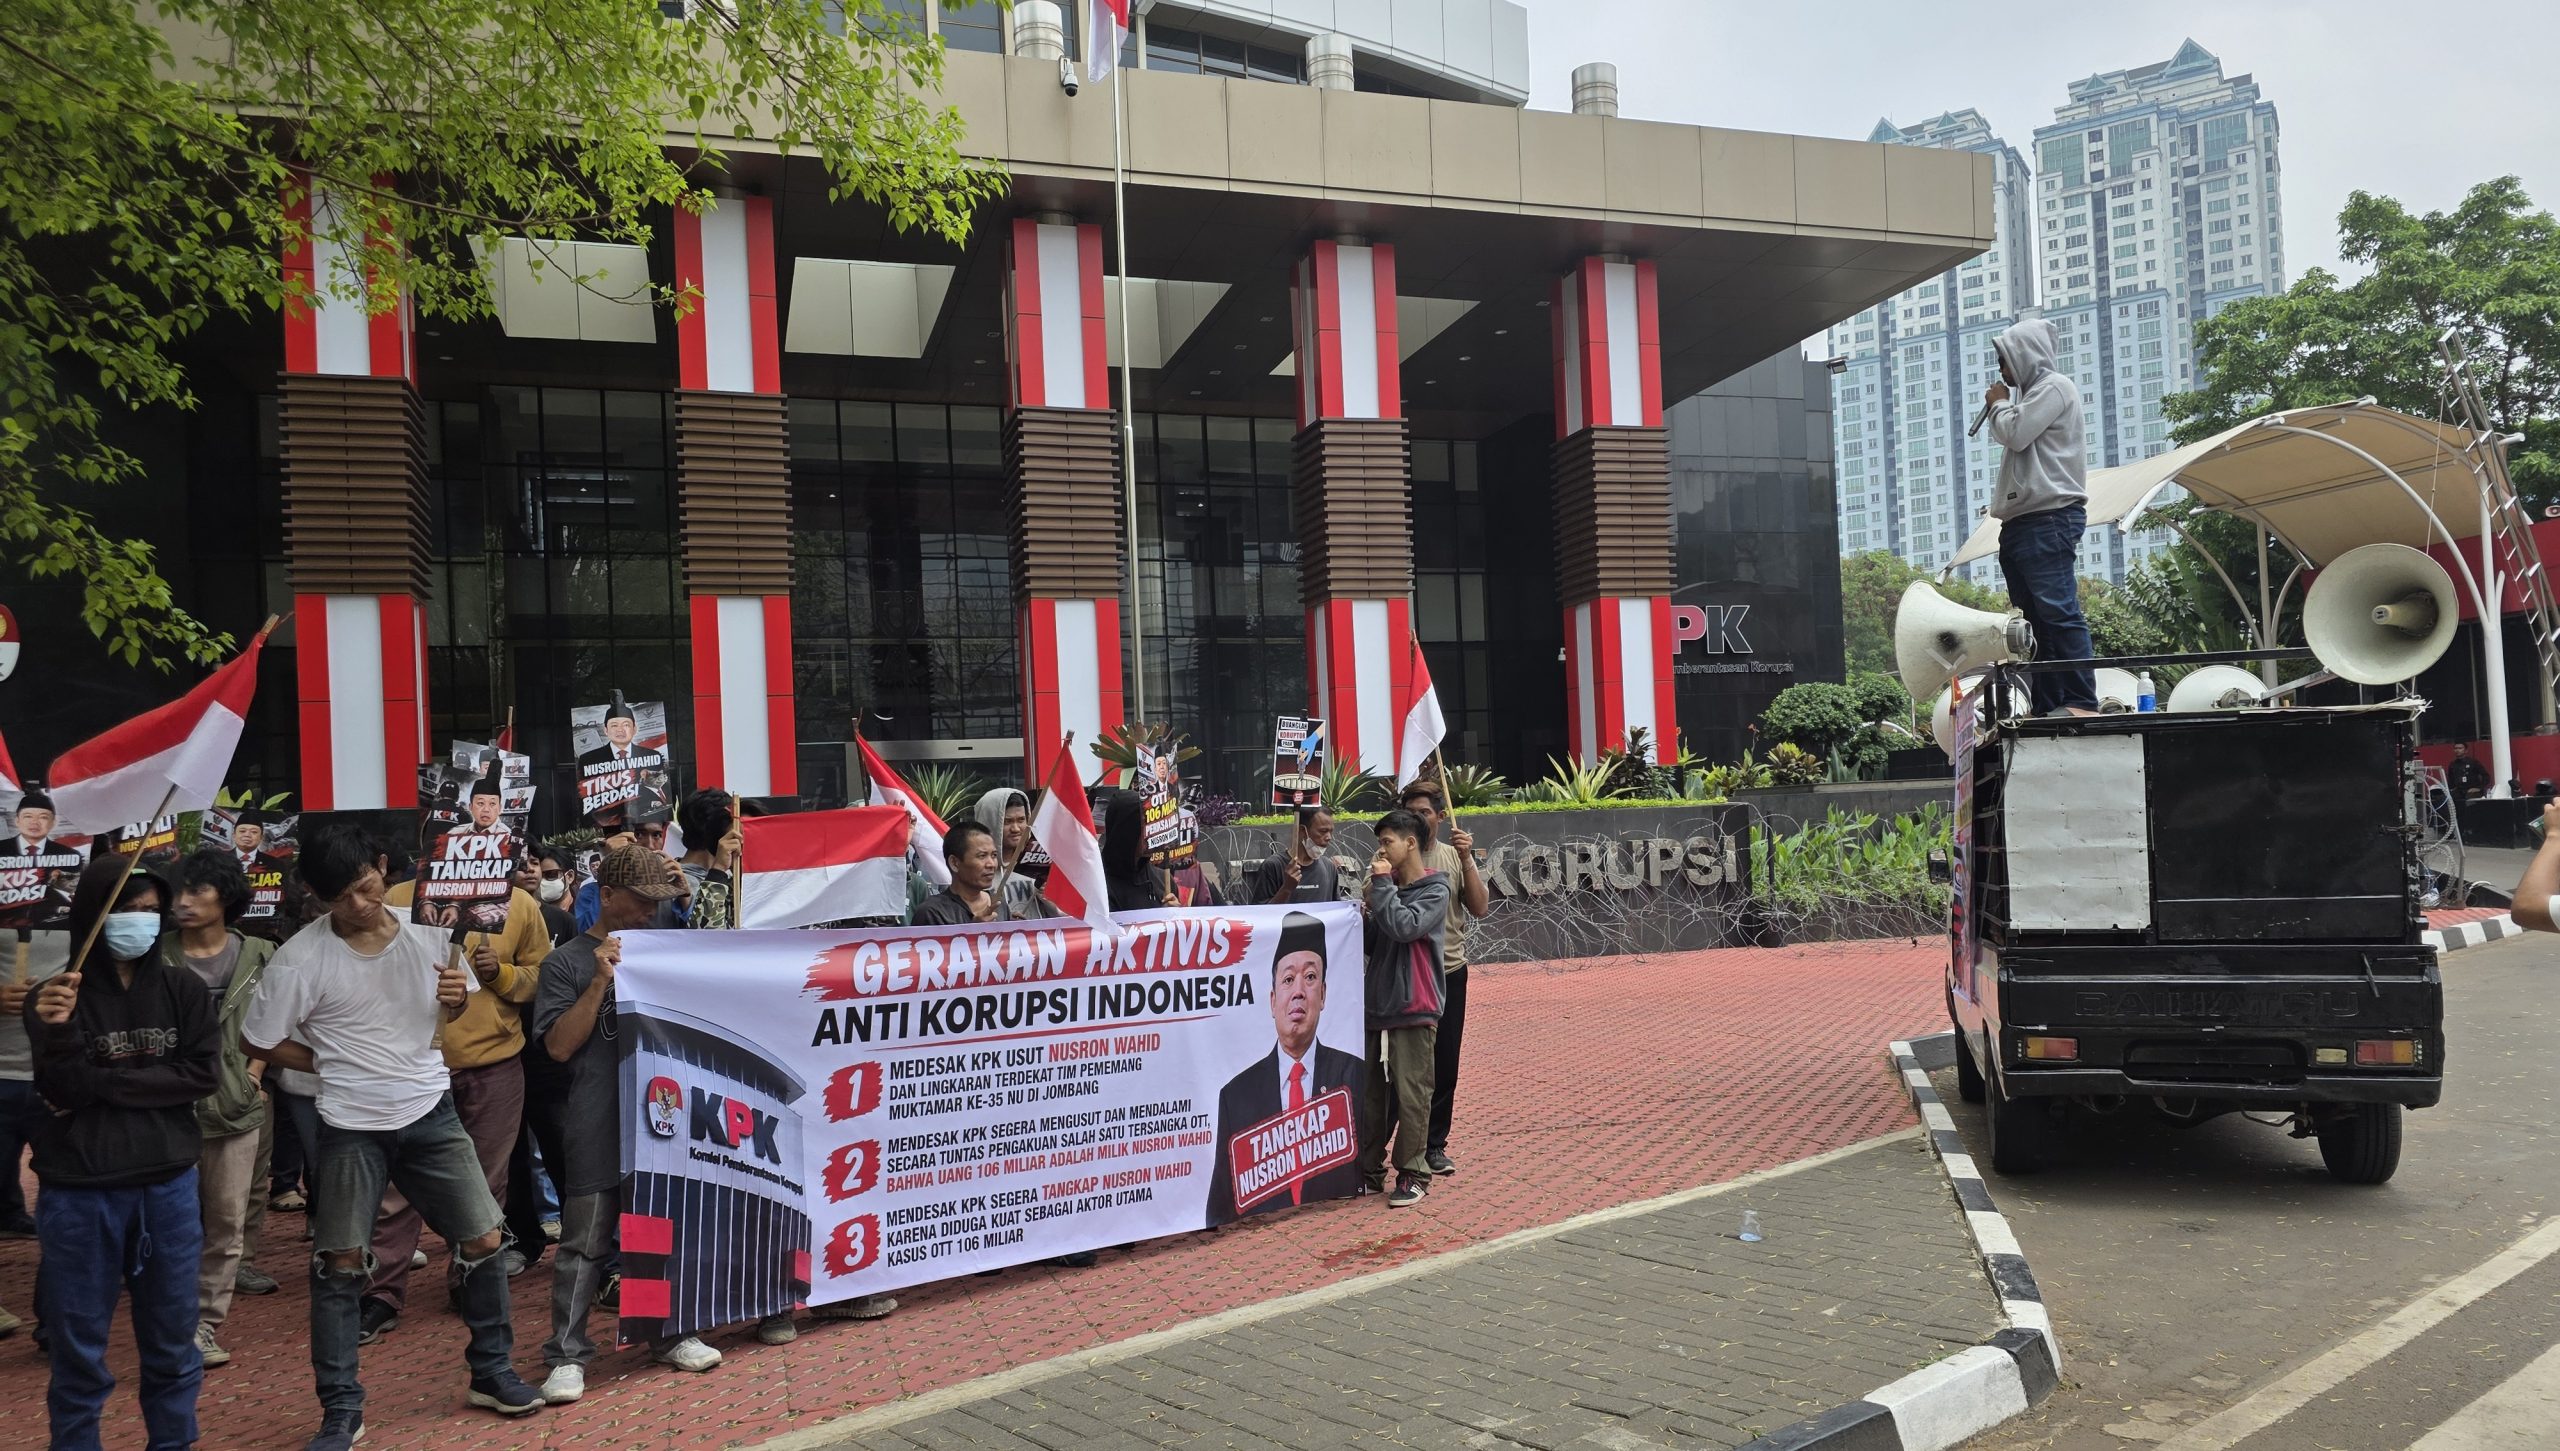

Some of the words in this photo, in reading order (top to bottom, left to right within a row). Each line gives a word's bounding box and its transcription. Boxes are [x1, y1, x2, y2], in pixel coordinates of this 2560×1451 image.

[1671, 604, 1753, 654] PK
[1673, 663, 1749, 675] mberantasan
[1750, 660, 1794, 675] Korupsi
[1279, 732, 1306, 740] KORUPTOR
[583, 769, 632, 796] TIKUS
[584, 758, 625, 777] NUSRON
[627, 754, 661, 769] WAHID
[433, 809, 460, 822] KPK
[504, 795, 529, 810] KPK
[582, 783, 639, 816] BERDASI
[1145, 807, 1161, 823] 106
[1151, 790, 1168, 807] OTT
[0, 855, 33, 869] SRON
[36, 854, 80, 868] WAHID
[119, 837, 158, 853] NUSON
[444, 834, 507, 860] KPK
[1473, 834, 1737, 896] KORUPSI
[425, 882, 474, 897] NUSRON
[477, 881, 507, 895] WAHID
[430, 859, 513, 880] TANGKAP
[254, 890, 282, 902] ADILI
[853, 929, 1067, 996] GERAKAN
[1084, 918, 1232, 977] AKTIVIS
[811, 1002, 909, 1047] ANTI
[919, 987, 1079, 1037] KORUPSI
[1087, 973, 1255, 1021] INDONESIA
[890, 1054, 967, 1080] MEDESAK
[971, 1050, 1002, 1071] KPK
[1006, 1046, 1044, 1068] USUT
[1049, 1038, 1109, 1062] NUSRON
[1114, 1033, 1161, 1055] WAHID
[848, 1068, 863, 1111] 1
[889, 1083, 916, 1101] DAN
[921, 1074, 991, 1097] LINGKARAN
[995, 1067, 1054, 1089] TERDEKAT
[1056, 1064, 1077, 1081] TIM
[1080, 1057, 1142, 1078] PEMEMANG
[889, 1098, 963, 1120] MUKTAMAR
[967, 1092, 1004, 1111] KE-35
[1007, 1089, 1024, 1106] NU
[1027, 1087, 1039, 1102] DI
[1042, 1080, 1099, 1101] JOMBANG
[655, 1120, 675, 1134] KPK
[690, 1086, 782, 1166] KPK
[887, 1155, 936, 1174] SECARA
[940, 1145, 985, 1166] TUNTAS
[988, 1134, 1057, 1158] PENGAKUAN
[1061, 1129, 1096, 1148] SALAH
[1098, 1125, 1125, 1142] SATU
[1128, 1117, 1187, 1138] TERSANGKA
[1190, 1113, 1211, 1130] OTT,
[888, 1130, 959, 1154] MENDESAK
[962, 1126, 988, 1144] KPK
[991, 1119, 1037, 1140] SEGERA
[1040, 1111, 1101, 1132] MENGUSUT
[1104, 1106, 1126, 1124] DAN
[1129, 1099, 1192, 1120] MENDALAMI
[1249, 1104, 1330, 1163] TANGKAP
[690, 1147, 721, 1166] Komisi
[722, 1154, 781, 1185] Pemberantasan
[841, 1147, 864, 1192] 2
[886, 1172, 934, 1194] BAHWA
[938, 1166, 973, 1185] UANG
[976, 1163, 1000, 1179] 106
[1003, 1155, 1046, 1175] MILIAR
[1049, 1149, 1094, 1168] ADALAH
[1097, 1142, 1129, 1160] MILIK
[1132, 1135, 1175, 1155] NUSRON
[1178, 1130, 1212, 1148] WAHID
[1239, 1148, 1296, 1198] NUSRON
[1298, 1127, 1348, 1167] WAHID
[886, 1200, 957, 1228] MENDESAK
[961, 1195, 987, 1214] KPK
[990, 1188, 1038, 1210] SEGERA
[1042, 1176, 1099, 1200] TANGKAP
[1102, 1168, 1151, 1190] NUSRON
[1154, 1161, 1192, 1182] WAHID
[887, 1224, 937, 1248] KARENA
[941, 1216, 988, 1237] DIDUGA
[991, 1210, 1022, 1229] KUAT
[1024, 1200, 1073, 1223] SEBAGAI
[1076, 1194, 1113, 1213] AKTOR
[1116, 1187, 1153, 1207] UTAMA
[844, 1222, 865, 1267] 3
[887, 1244, 927, 1268] KASUS
[931, 1240, 953, 1257] OTT
[957, 1235, 980, 1254] 106
[983, 1228, 1024, 1249] MILIAR
